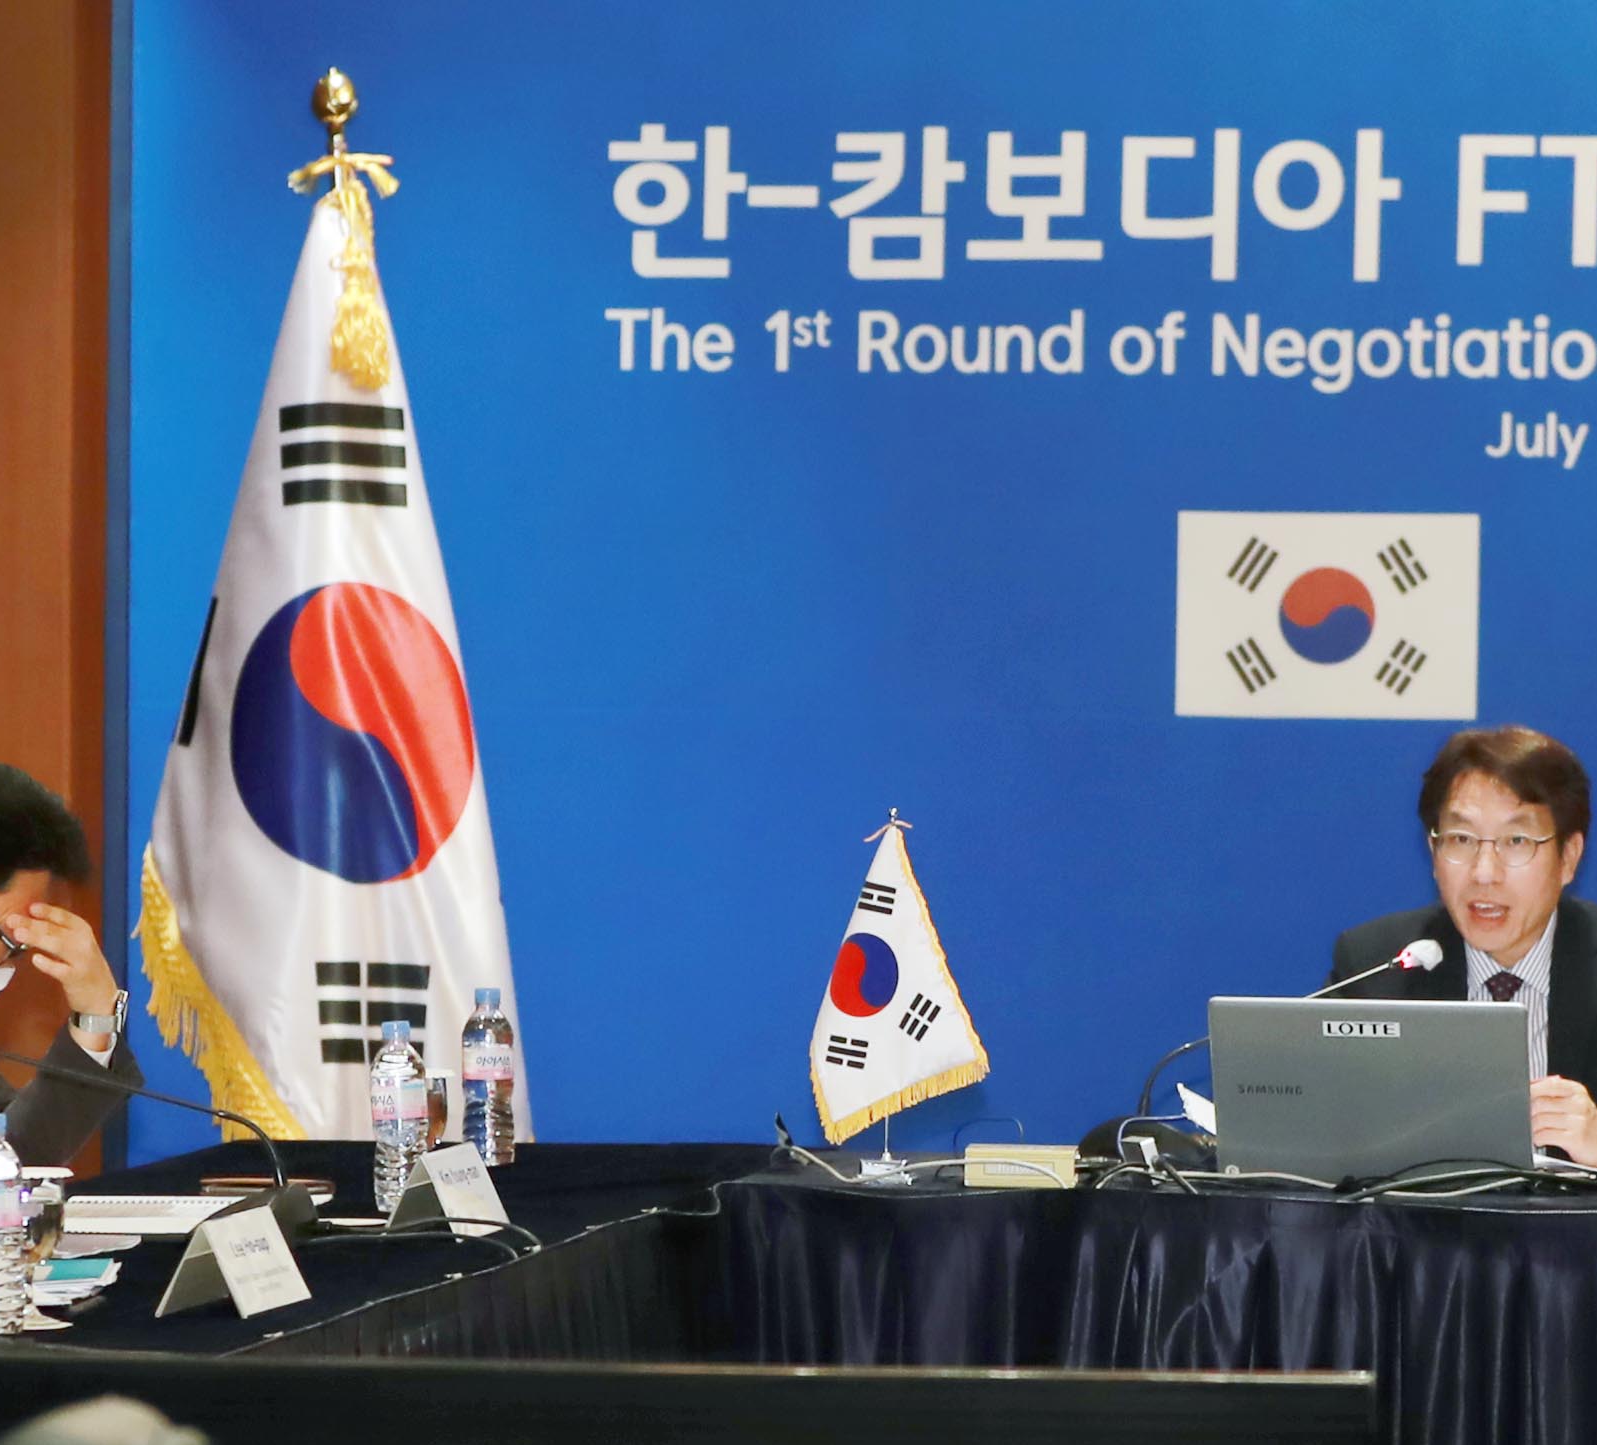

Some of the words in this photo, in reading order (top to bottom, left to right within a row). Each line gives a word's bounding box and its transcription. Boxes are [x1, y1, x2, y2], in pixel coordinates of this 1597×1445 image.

[607, 122, 1401, 282] 한-캄보디아
[604, 307, 735, 372] The
[764, 310, 832, 372] 1st
[857, 309, 1084, 374] Round
[1109, 311, 1186, 375] of
[1484, 411, 1589, 469] July
[1325, 1022, 1397, 1036] LOTTE
[1237, 1083, 1304, 1096] SAMSUNG
